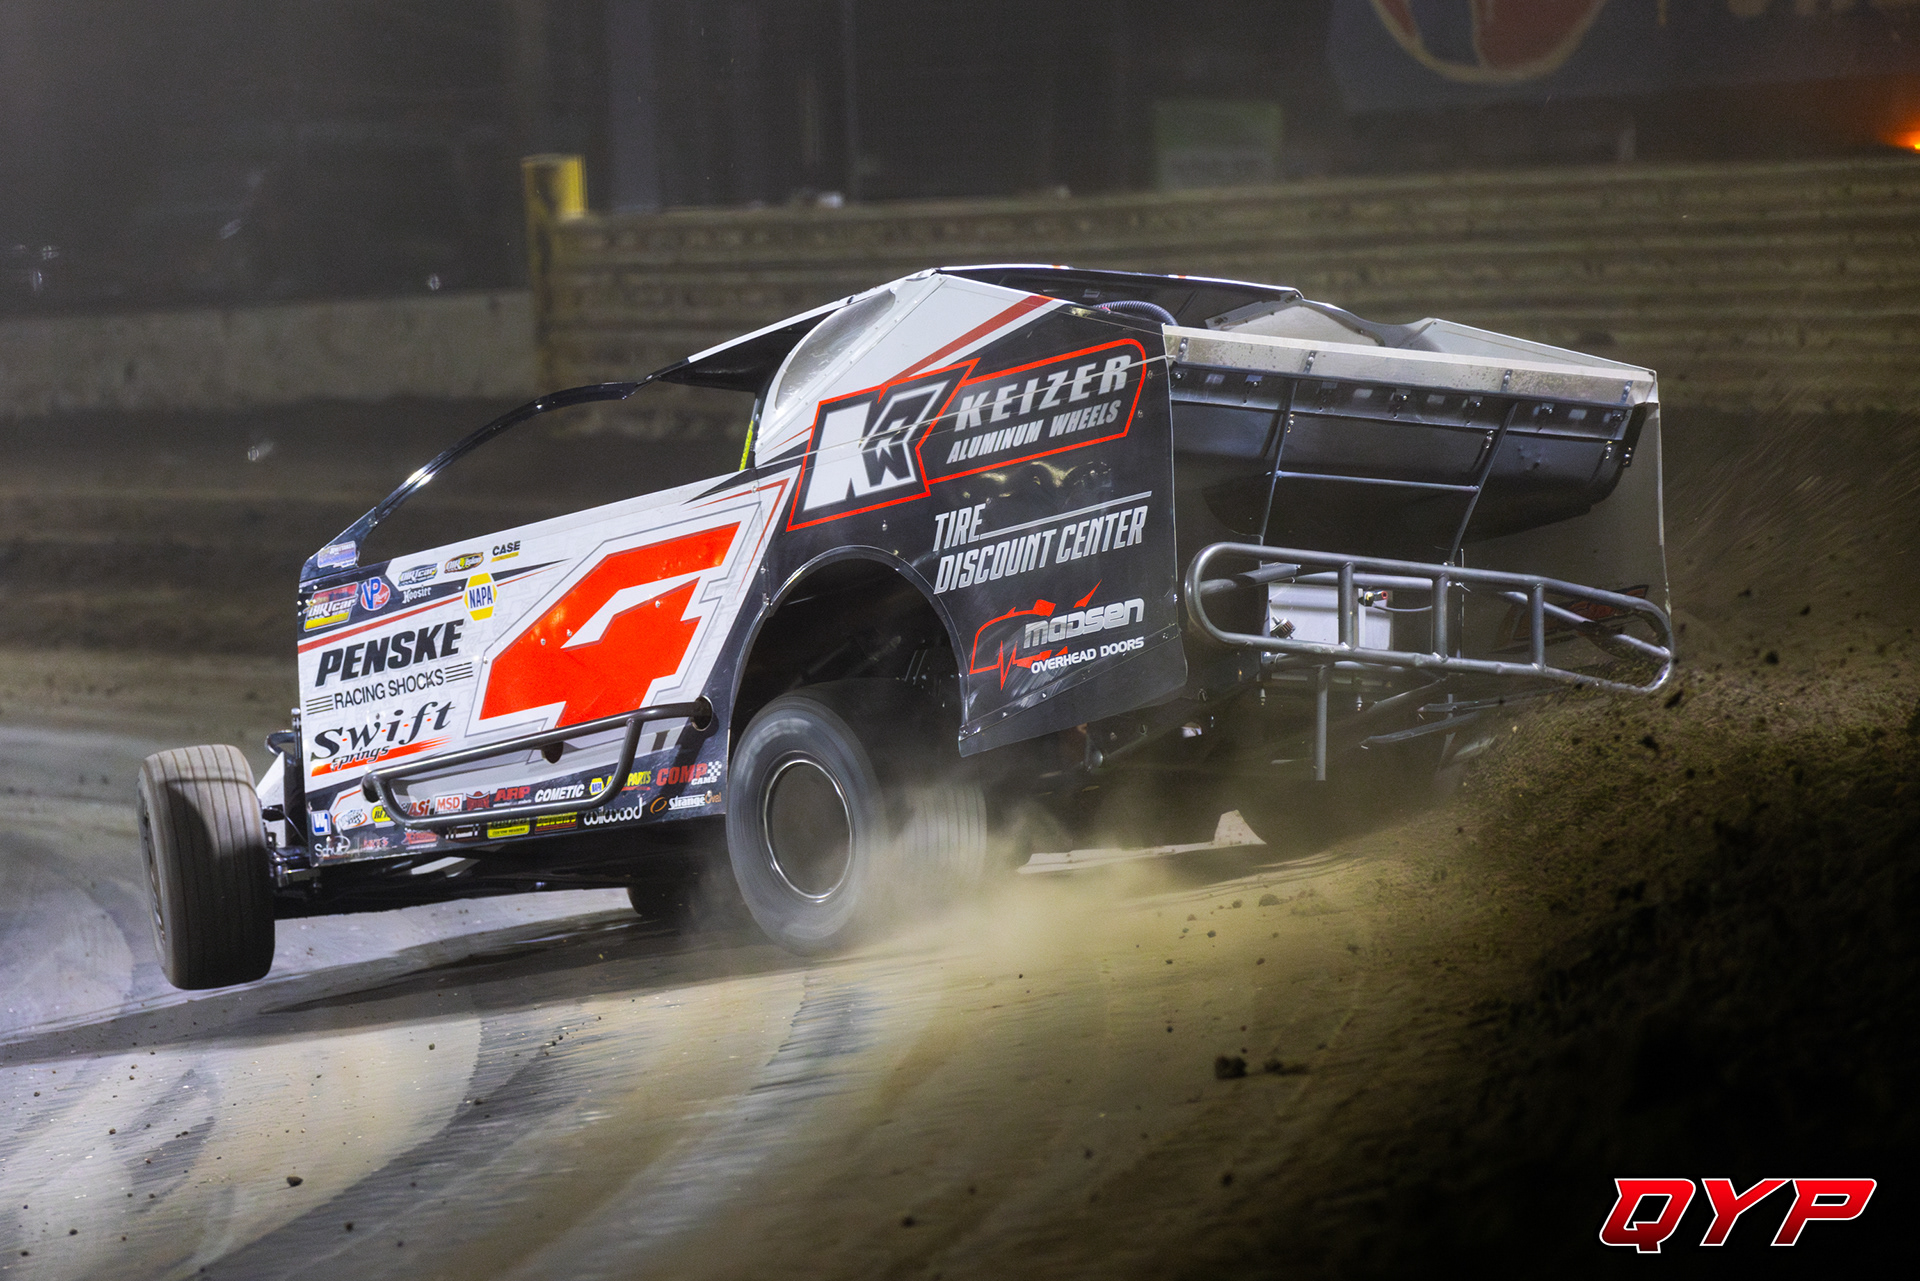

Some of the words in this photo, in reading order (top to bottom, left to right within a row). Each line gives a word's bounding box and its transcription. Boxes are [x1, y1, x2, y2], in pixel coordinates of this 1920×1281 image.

[954, 355, 1132, 432] KEIZER
[946, 419, 1044, 464] ALUMINUM
[1049, 400, 1121, 438] WHEELS
[932, 503, 986, 552] TIRE
[492, 541, 521, 556] CASE
[933, 529, 1058, 595] DISCOUNT
[1055, 505, 1149, 564] CENTER
[361, 576, 382, 610] VP
[402, 586, 432, 604] Hoosier
[469, 585, 493, 609] NAPA
[315, 619, 465, 687] PENSKE
[1031, 649, 1097, 674] OVERHEAD
[1100, 636, 1145, 658] DOORS
[334, 683, 387, 709] RACING
[388, 669, 445, 697] SHOCKS
[311, 701, 456, 762] Swift
[628, 771, 652, 786] PARTS
[656, 763, 708, 786] COMP
[691, 775, 718, 786] CAMS
[437, 796, 461, 810] MSD
[494, 786, 531, 802] ARP
[534, 784, 585, 803] COMETIC
[668, 794, 705, 809] Strange
